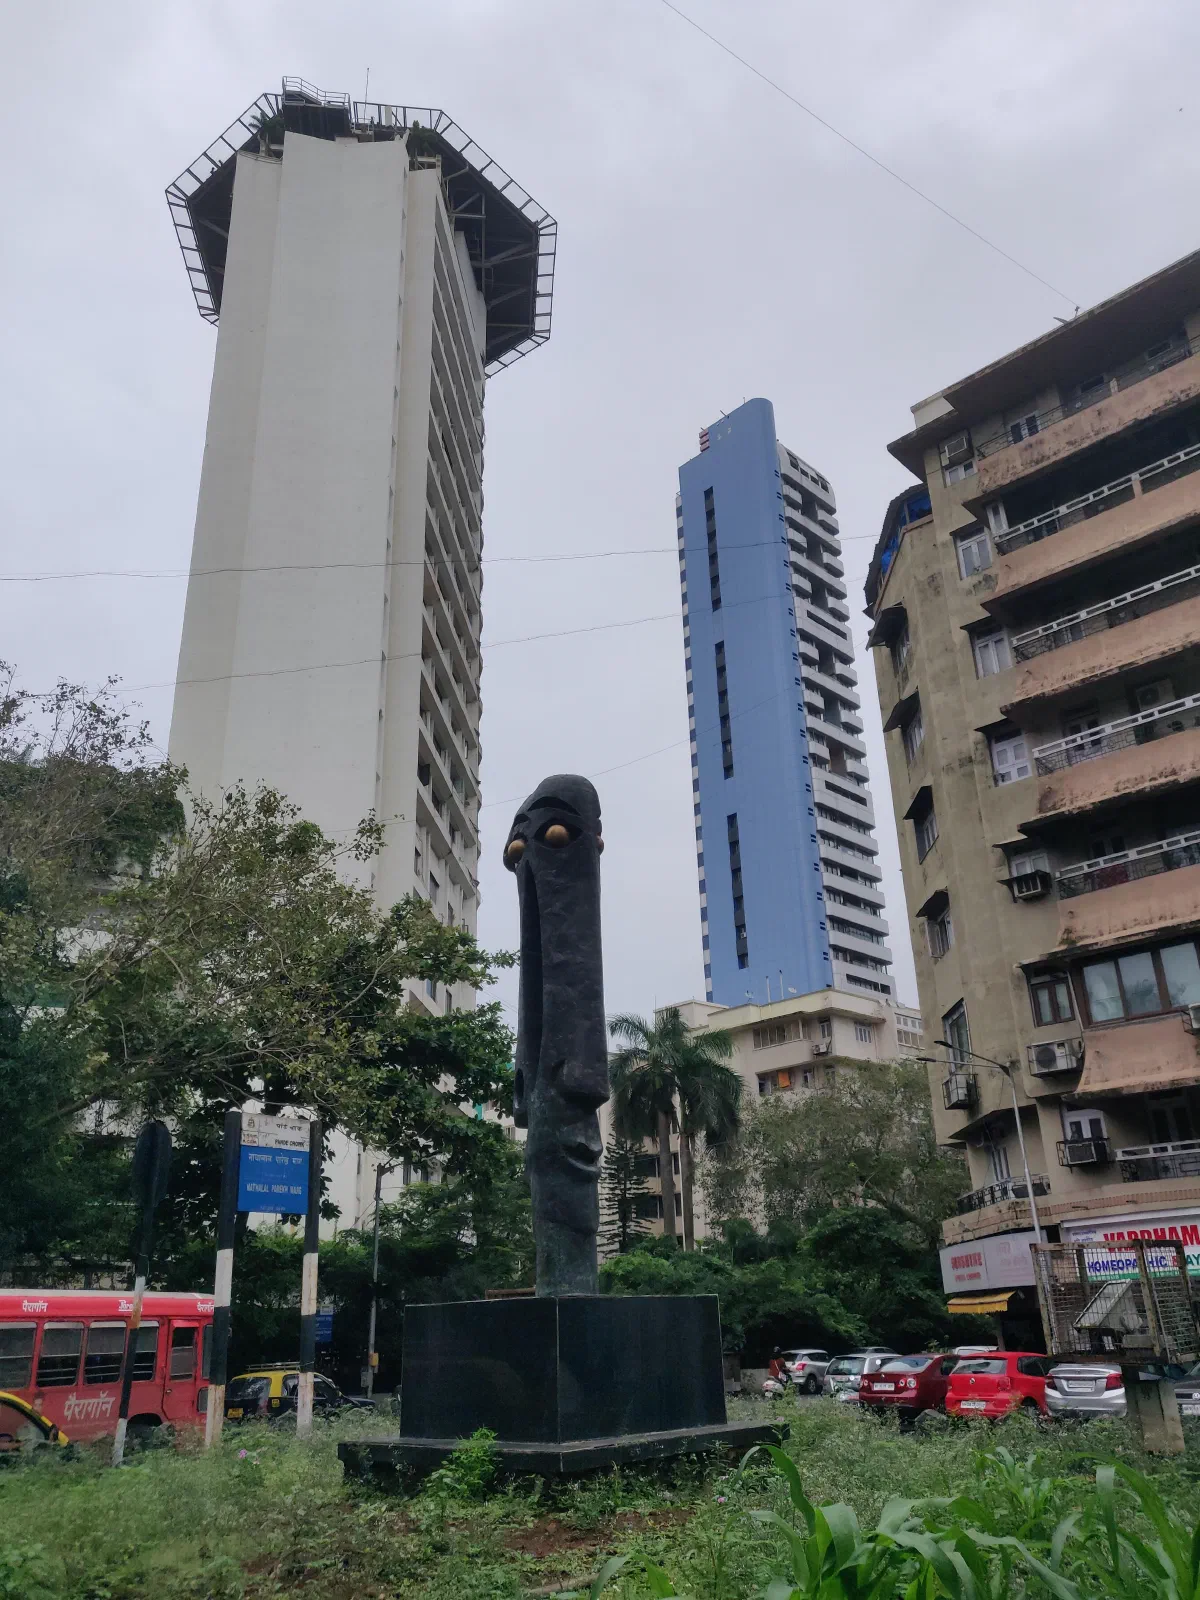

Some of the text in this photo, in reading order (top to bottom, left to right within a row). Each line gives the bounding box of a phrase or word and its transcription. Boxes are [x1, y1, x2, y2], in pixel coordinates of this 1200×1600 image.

[247, 1183, 302, 1195] NATHALAL PAREKH MARG
[1087, 1256, 1168, 1273] HOMEOPAHIC
